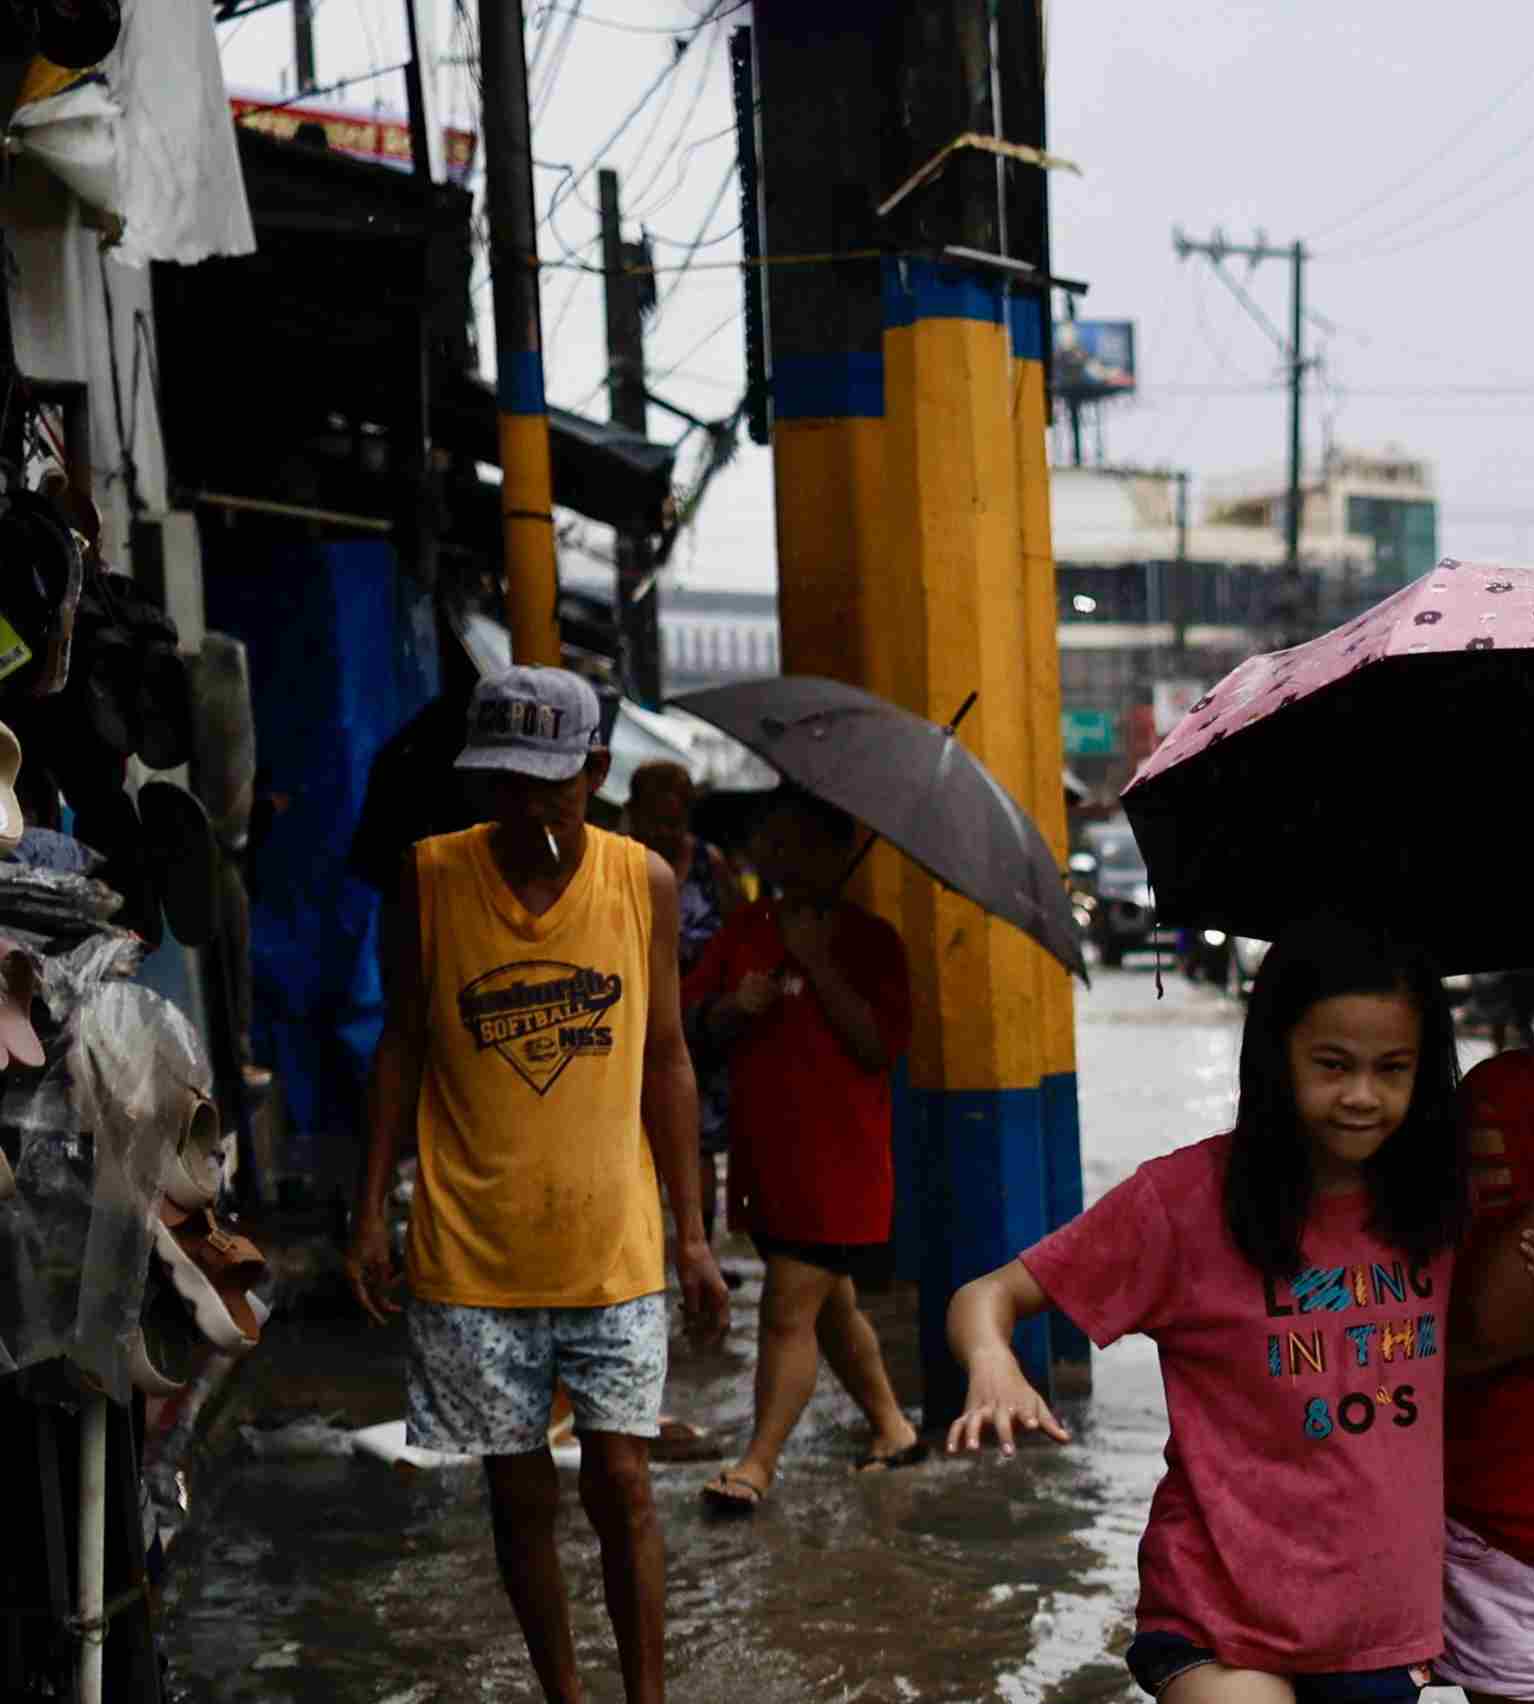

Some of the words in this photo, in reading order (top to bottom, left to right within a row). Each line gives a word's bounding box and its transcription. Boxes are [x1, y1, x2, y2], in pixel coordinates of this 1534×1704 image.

[480, 1002, 590, 1045] SOFTBALL
[1267, 1327, 1328, 1379] IN
[1345, 1311, 1440, 1368] THE
